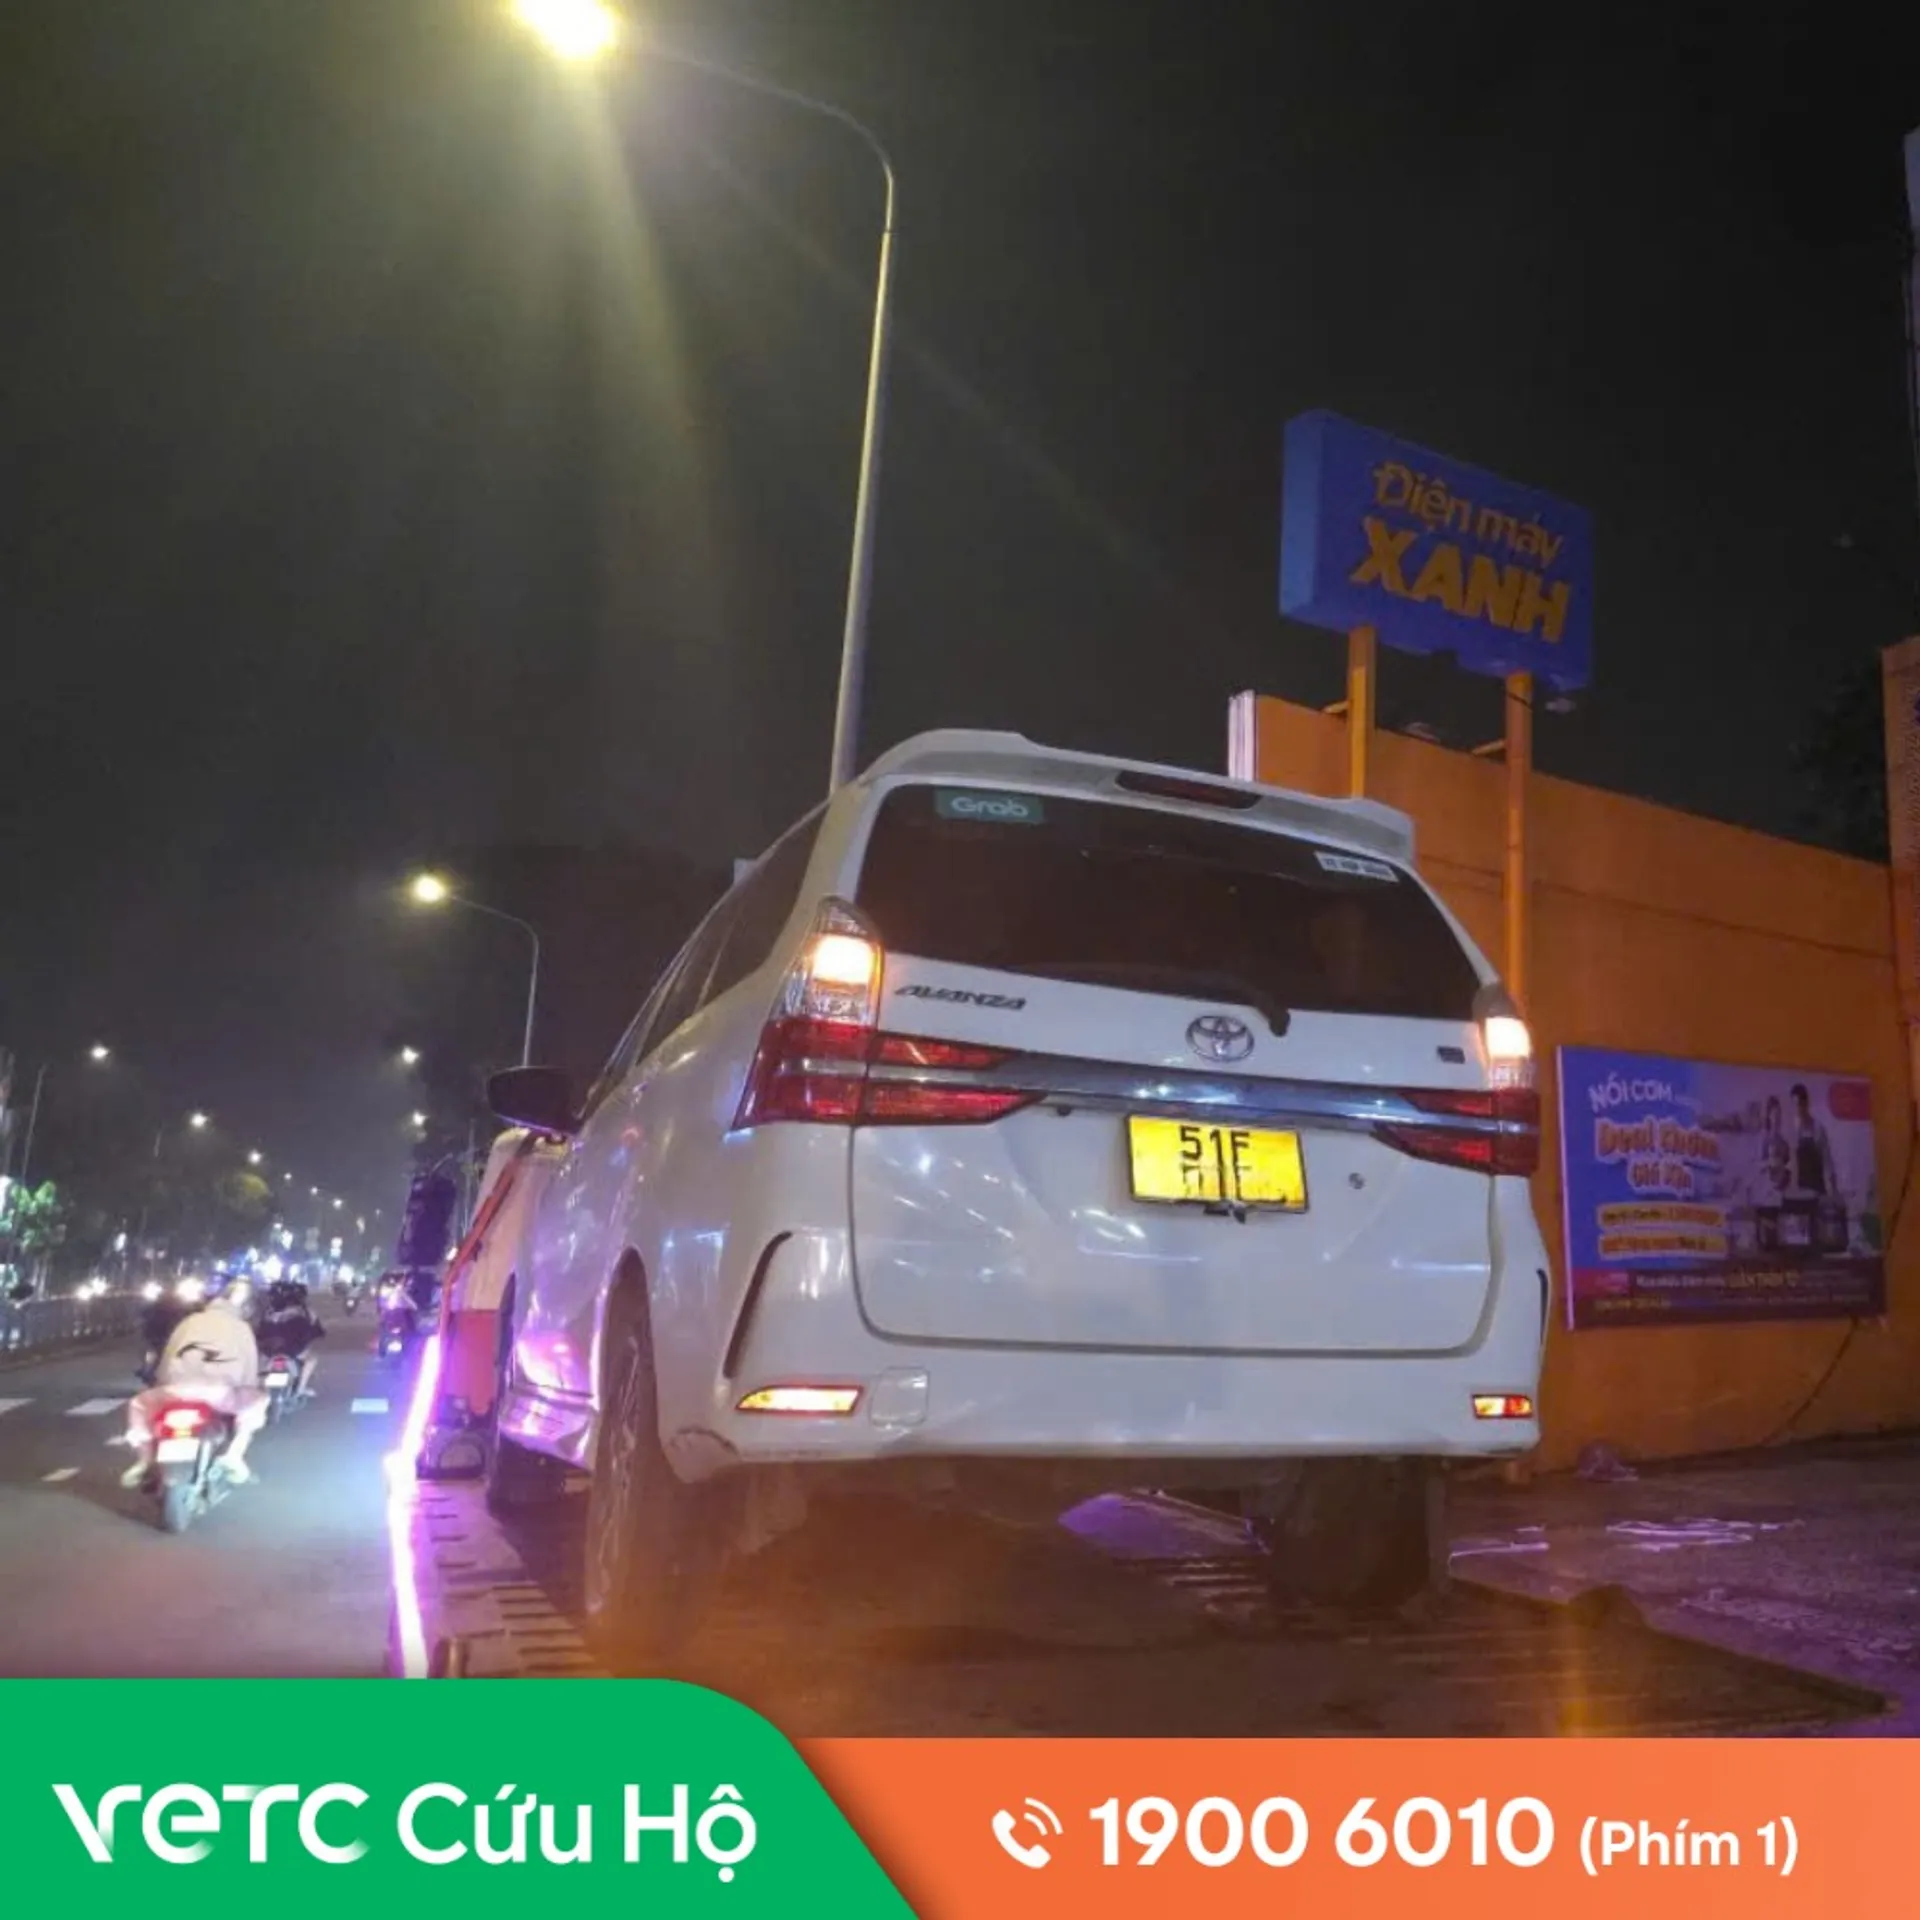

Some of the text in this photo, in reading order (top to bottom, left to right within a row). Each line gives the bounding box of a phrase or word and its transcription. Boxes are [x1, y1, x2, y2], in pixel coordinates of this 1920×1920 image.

[1373, 461, 1564, 568] Điện máy
[1351, 516, 1570, 644] XANH
[950, 796, 1029, 818] Grab
[894, 985, 1027, 1011] AVANZA
